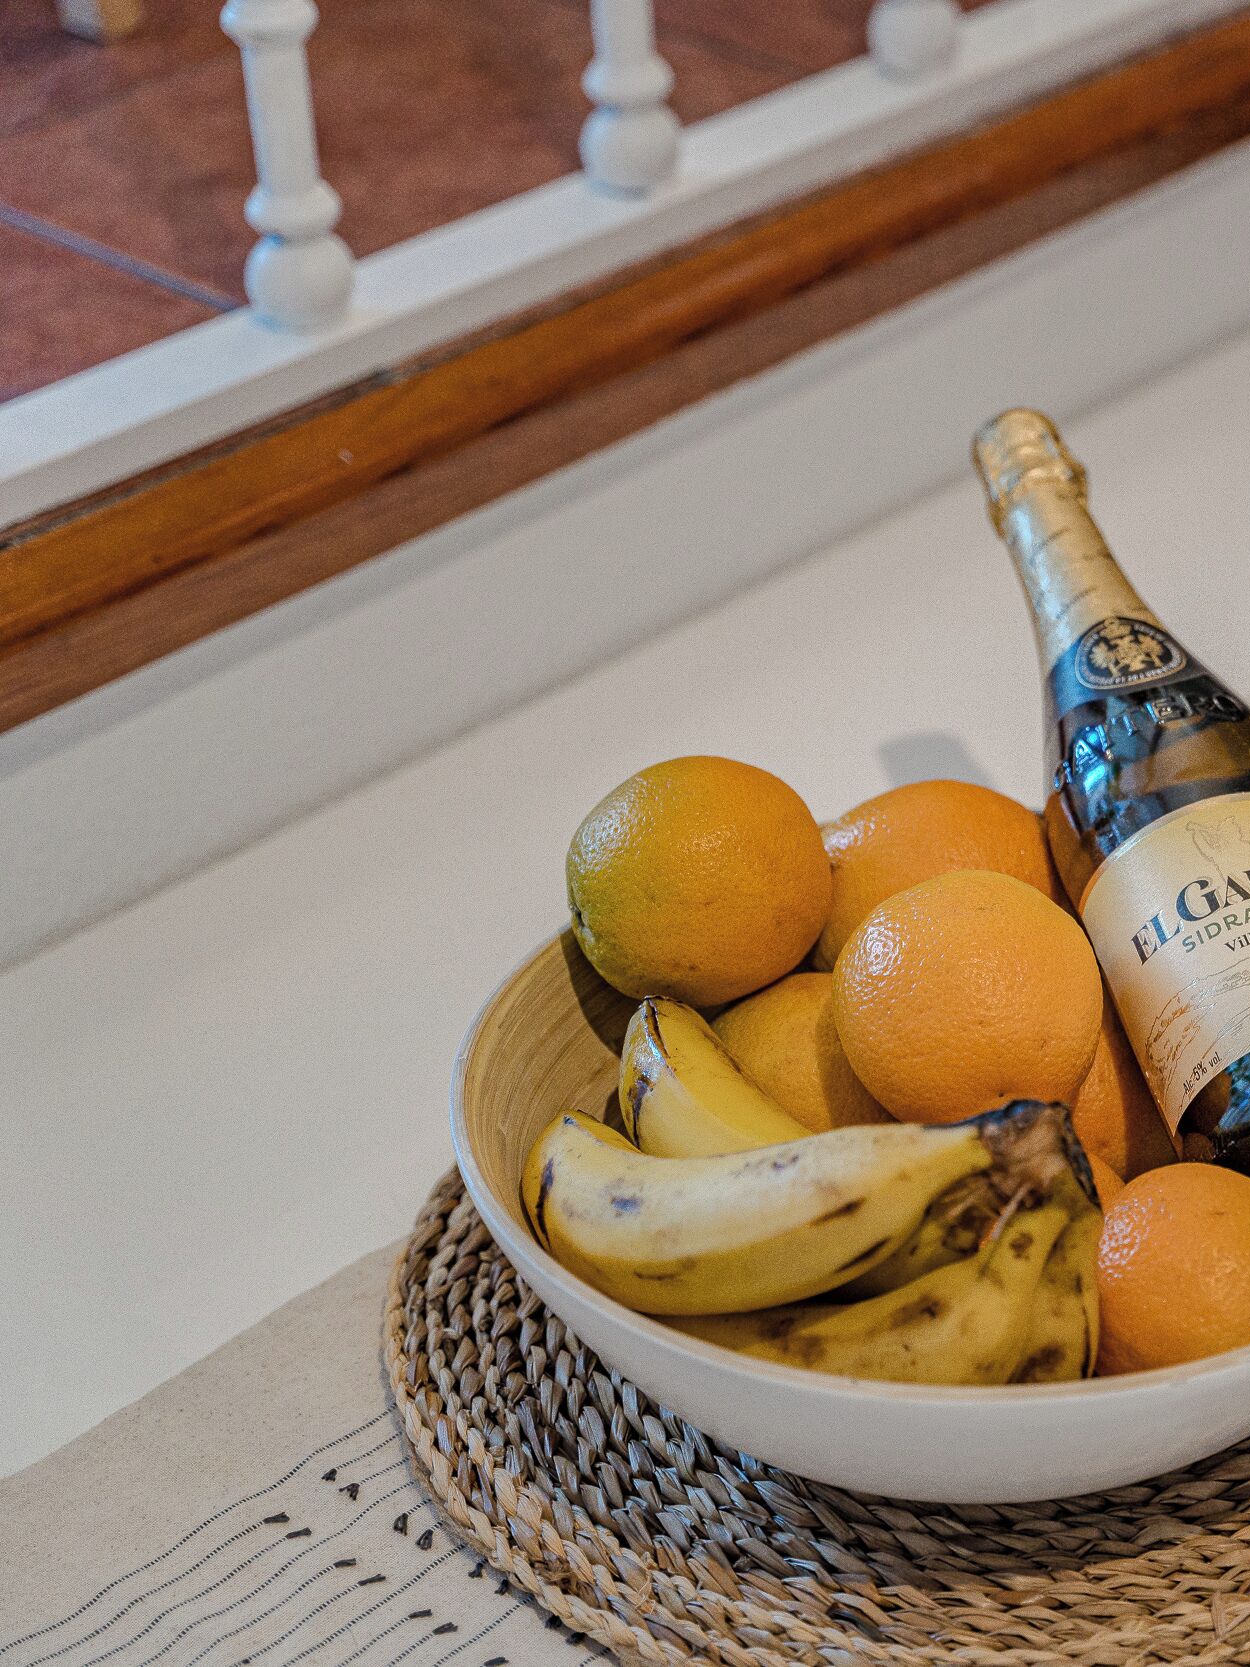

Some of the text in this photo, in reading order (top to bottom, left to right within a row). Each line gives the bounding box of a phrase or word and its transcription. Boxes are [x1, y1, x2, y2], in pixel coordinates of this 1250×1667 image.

[1131, 909, 1184, 966] EL
[1192, 1061, 1208, 1081] 5%
[1208, 1051, 1223, 1068] vol.
